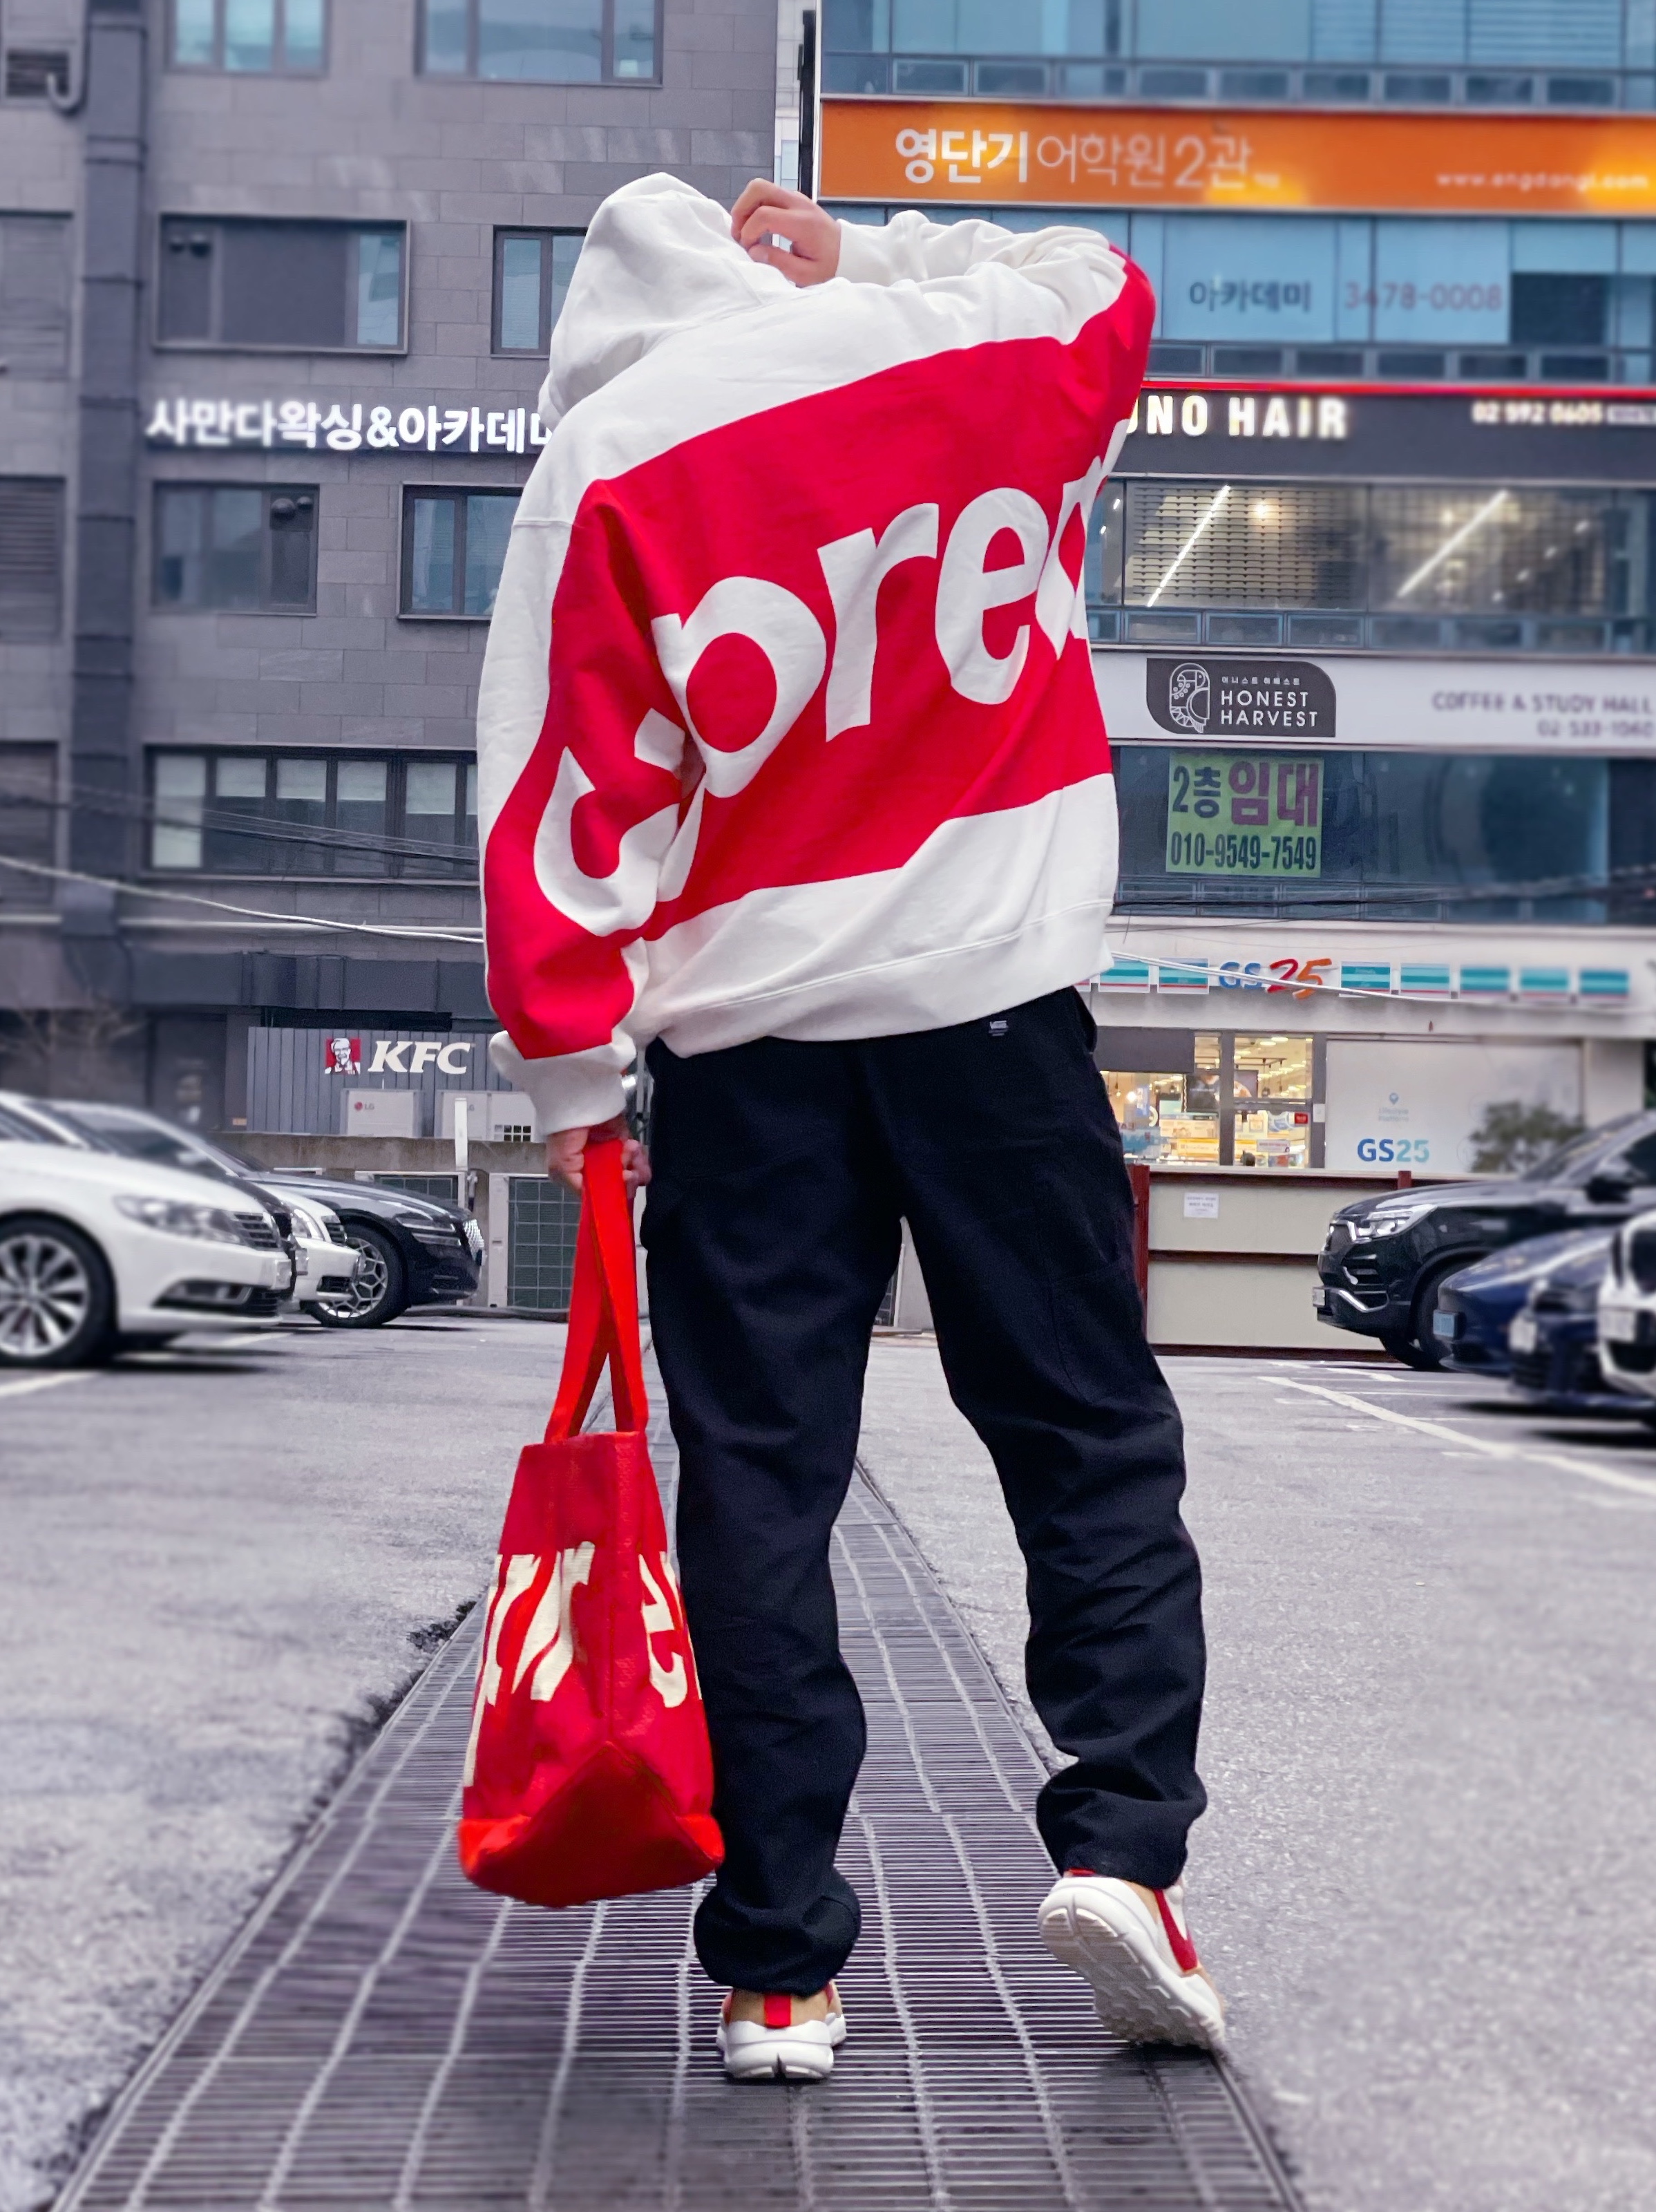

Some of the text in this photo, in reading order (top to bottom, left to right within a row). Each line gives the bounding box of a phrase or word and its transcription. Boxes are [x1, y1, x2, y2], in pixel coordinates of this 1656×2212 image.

[896, 129, 1028, 184] 영단기
[1190, 280, 1311, 313] 아카데미
[1228, 397, 1346, 439] HAIR
[1221, 690, 1308, 707] HONEST
[1532, 693, 1595, 713] STUDY
[1603, 694, 1653, 714] HALL
[1221, 709, 1317, 726] HARVEST
[1172, 761, 1319, 826] 2층 임대
[1171, 831, 1317, 869] 010-9549-7549
[1219, 958, 1332, 999] GS25
[368, 1041, 470, 1074] KFC
[1357, 1138, 1429, 1162] GS25
